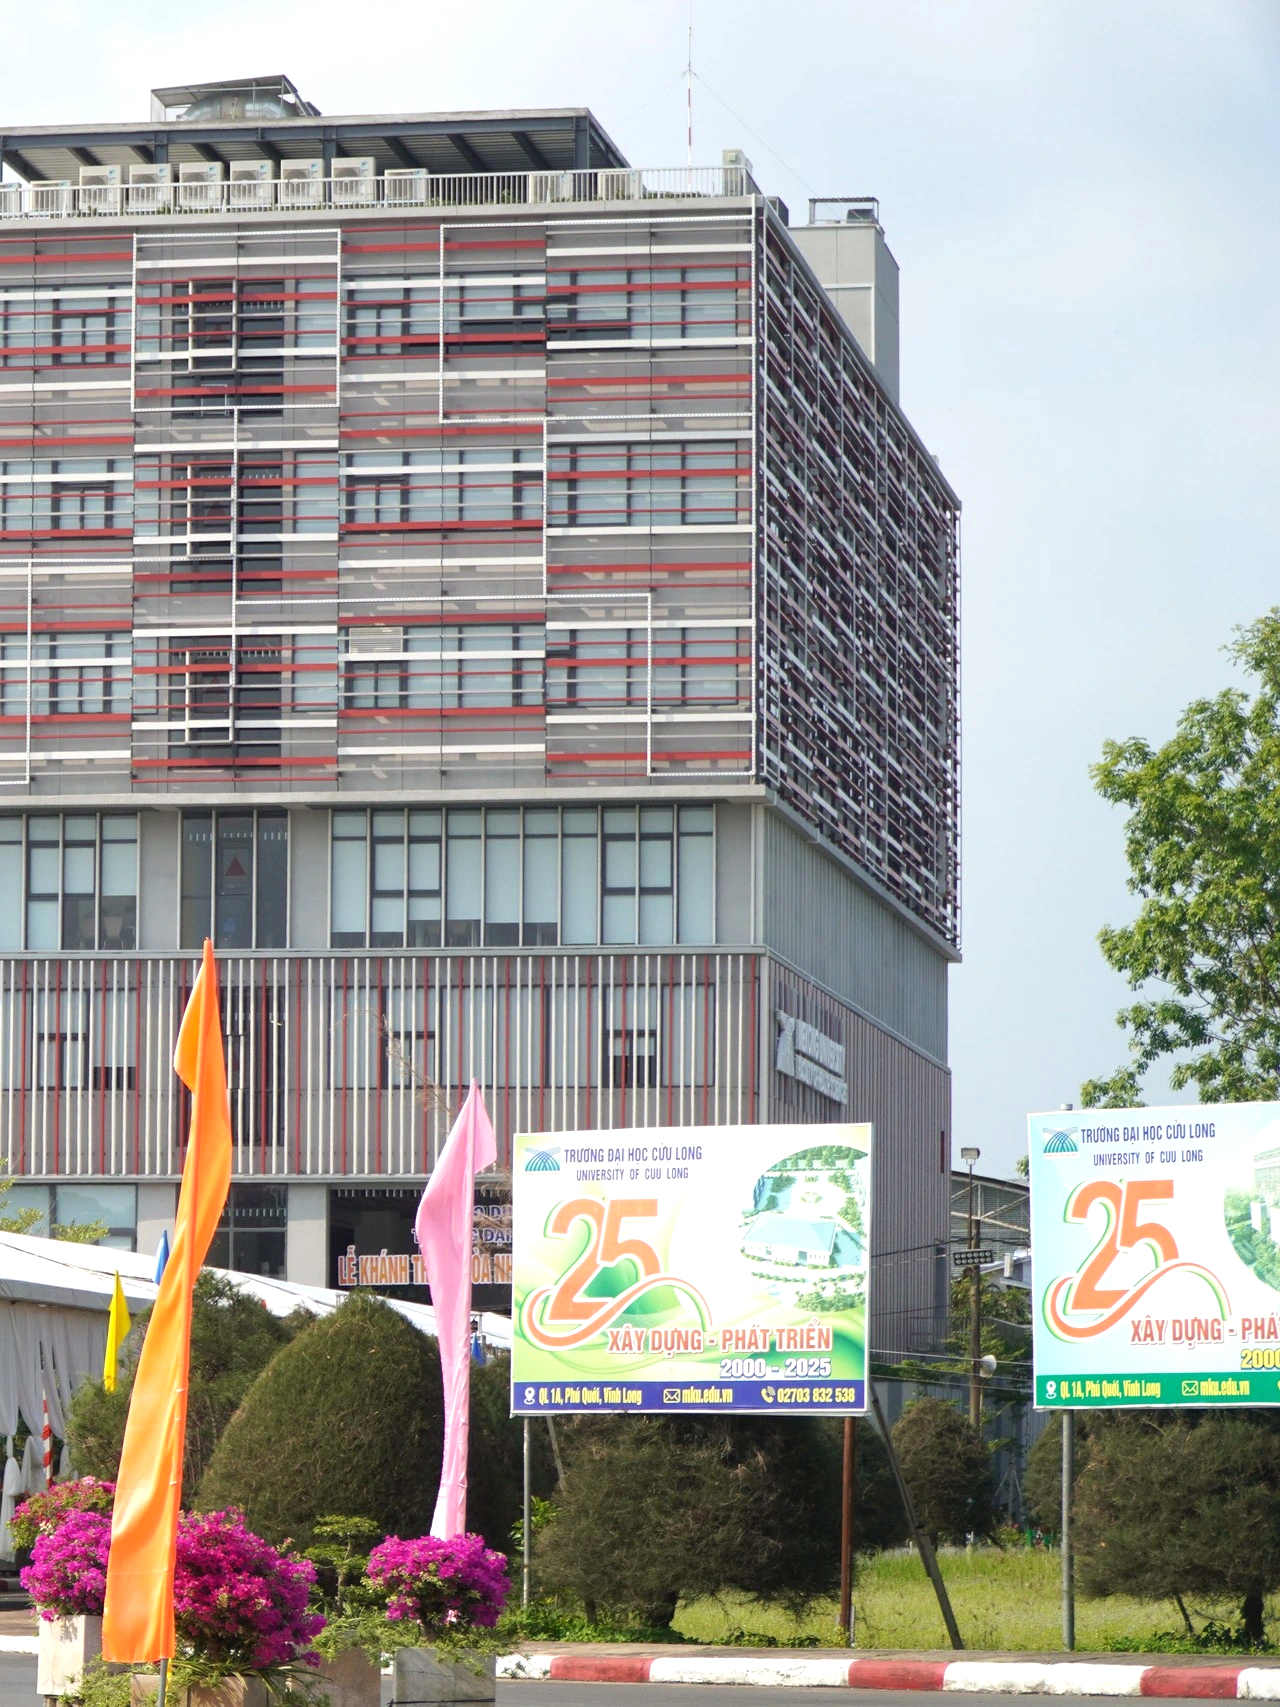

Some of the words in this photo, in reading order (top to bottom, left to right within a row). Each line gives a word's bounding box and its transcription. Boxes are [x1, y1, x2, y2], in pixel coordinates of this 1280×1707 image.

[1081, 1125, 1120, 1143] TRƯỜNG
[1123, 1127, 1139, 1145] ĐẠI
[1143, 1125, 1162, 1144] HỌC
[1166, 1119, 1186, 1139] CỬU
[1189, 1123, 1216, 1138] LONG
[564, 1145, 604, 1163] TRƯỜNG
[608, 1148, 624, 1165] ĐẠI
[628, 1147, 648, 1165] HỌC
[652, 1142, 672, 1161] CỬU
[676, 1146, 702, 1160] LONG
[1093, 1152, 1140, 1166] UNIVERSITY
[1145, 1152, 1155, 1164] OF
[1160, 1151, 1177, 1163] CUU
[1182, 1150, 1203, 1162] LONG
[576, 1169, 624, 1181] UNIVERSITY
[629, 1169, 639, 1180] OF
[645, 1168, 661, 1180] CUU
[667, 1167, 689, 1180] LONG
[1070, 1179, 1180, 1310] 25
[338, 1245, 356, 1285] LỄ
[359, 1249, 409, 1285] KHÁNH
[548, 1198, 661, 1320] 25
[609, 1326, 645, 1351] XÂY
[651, 1328, 703, 1356] DỰNG
[722, 1325, 770, 1350] PHÁT
[776, 1319, 831, 1350] TRIỂN
[1131, 1315, 1166, 1343] XÂY
[1172, 1317, 1221, 1347] DỰNG
[1241, 1312, 1280, 1341] PHÁ
[720, 1358, 766, 1379] 2000
[784, 1357, 832, 1379] 2025
[538, 1388, 548, 1405] QL
[551, 1387, 563, 1405] 1A,
[565, 1387, 580, 1404] Phú
[623, 1388, 642, 1405] Long
[682, 1386, 733, 1403] mku.edu.vn
[777, 1388, 809, 1403] 02703
[813, 1388, 832, 1402] 832
[835, 1388, 855, 1402] 538
[1060, 1382, 1070, 1399] QL
[1071, 1382, 1084, 1399] 1A,
[1085, 1381, 1100, 1397] Phú
[1142, 1380, 1161, 1398] Long
[1200, 1378, 1250, 1396] mku.edu.vn
